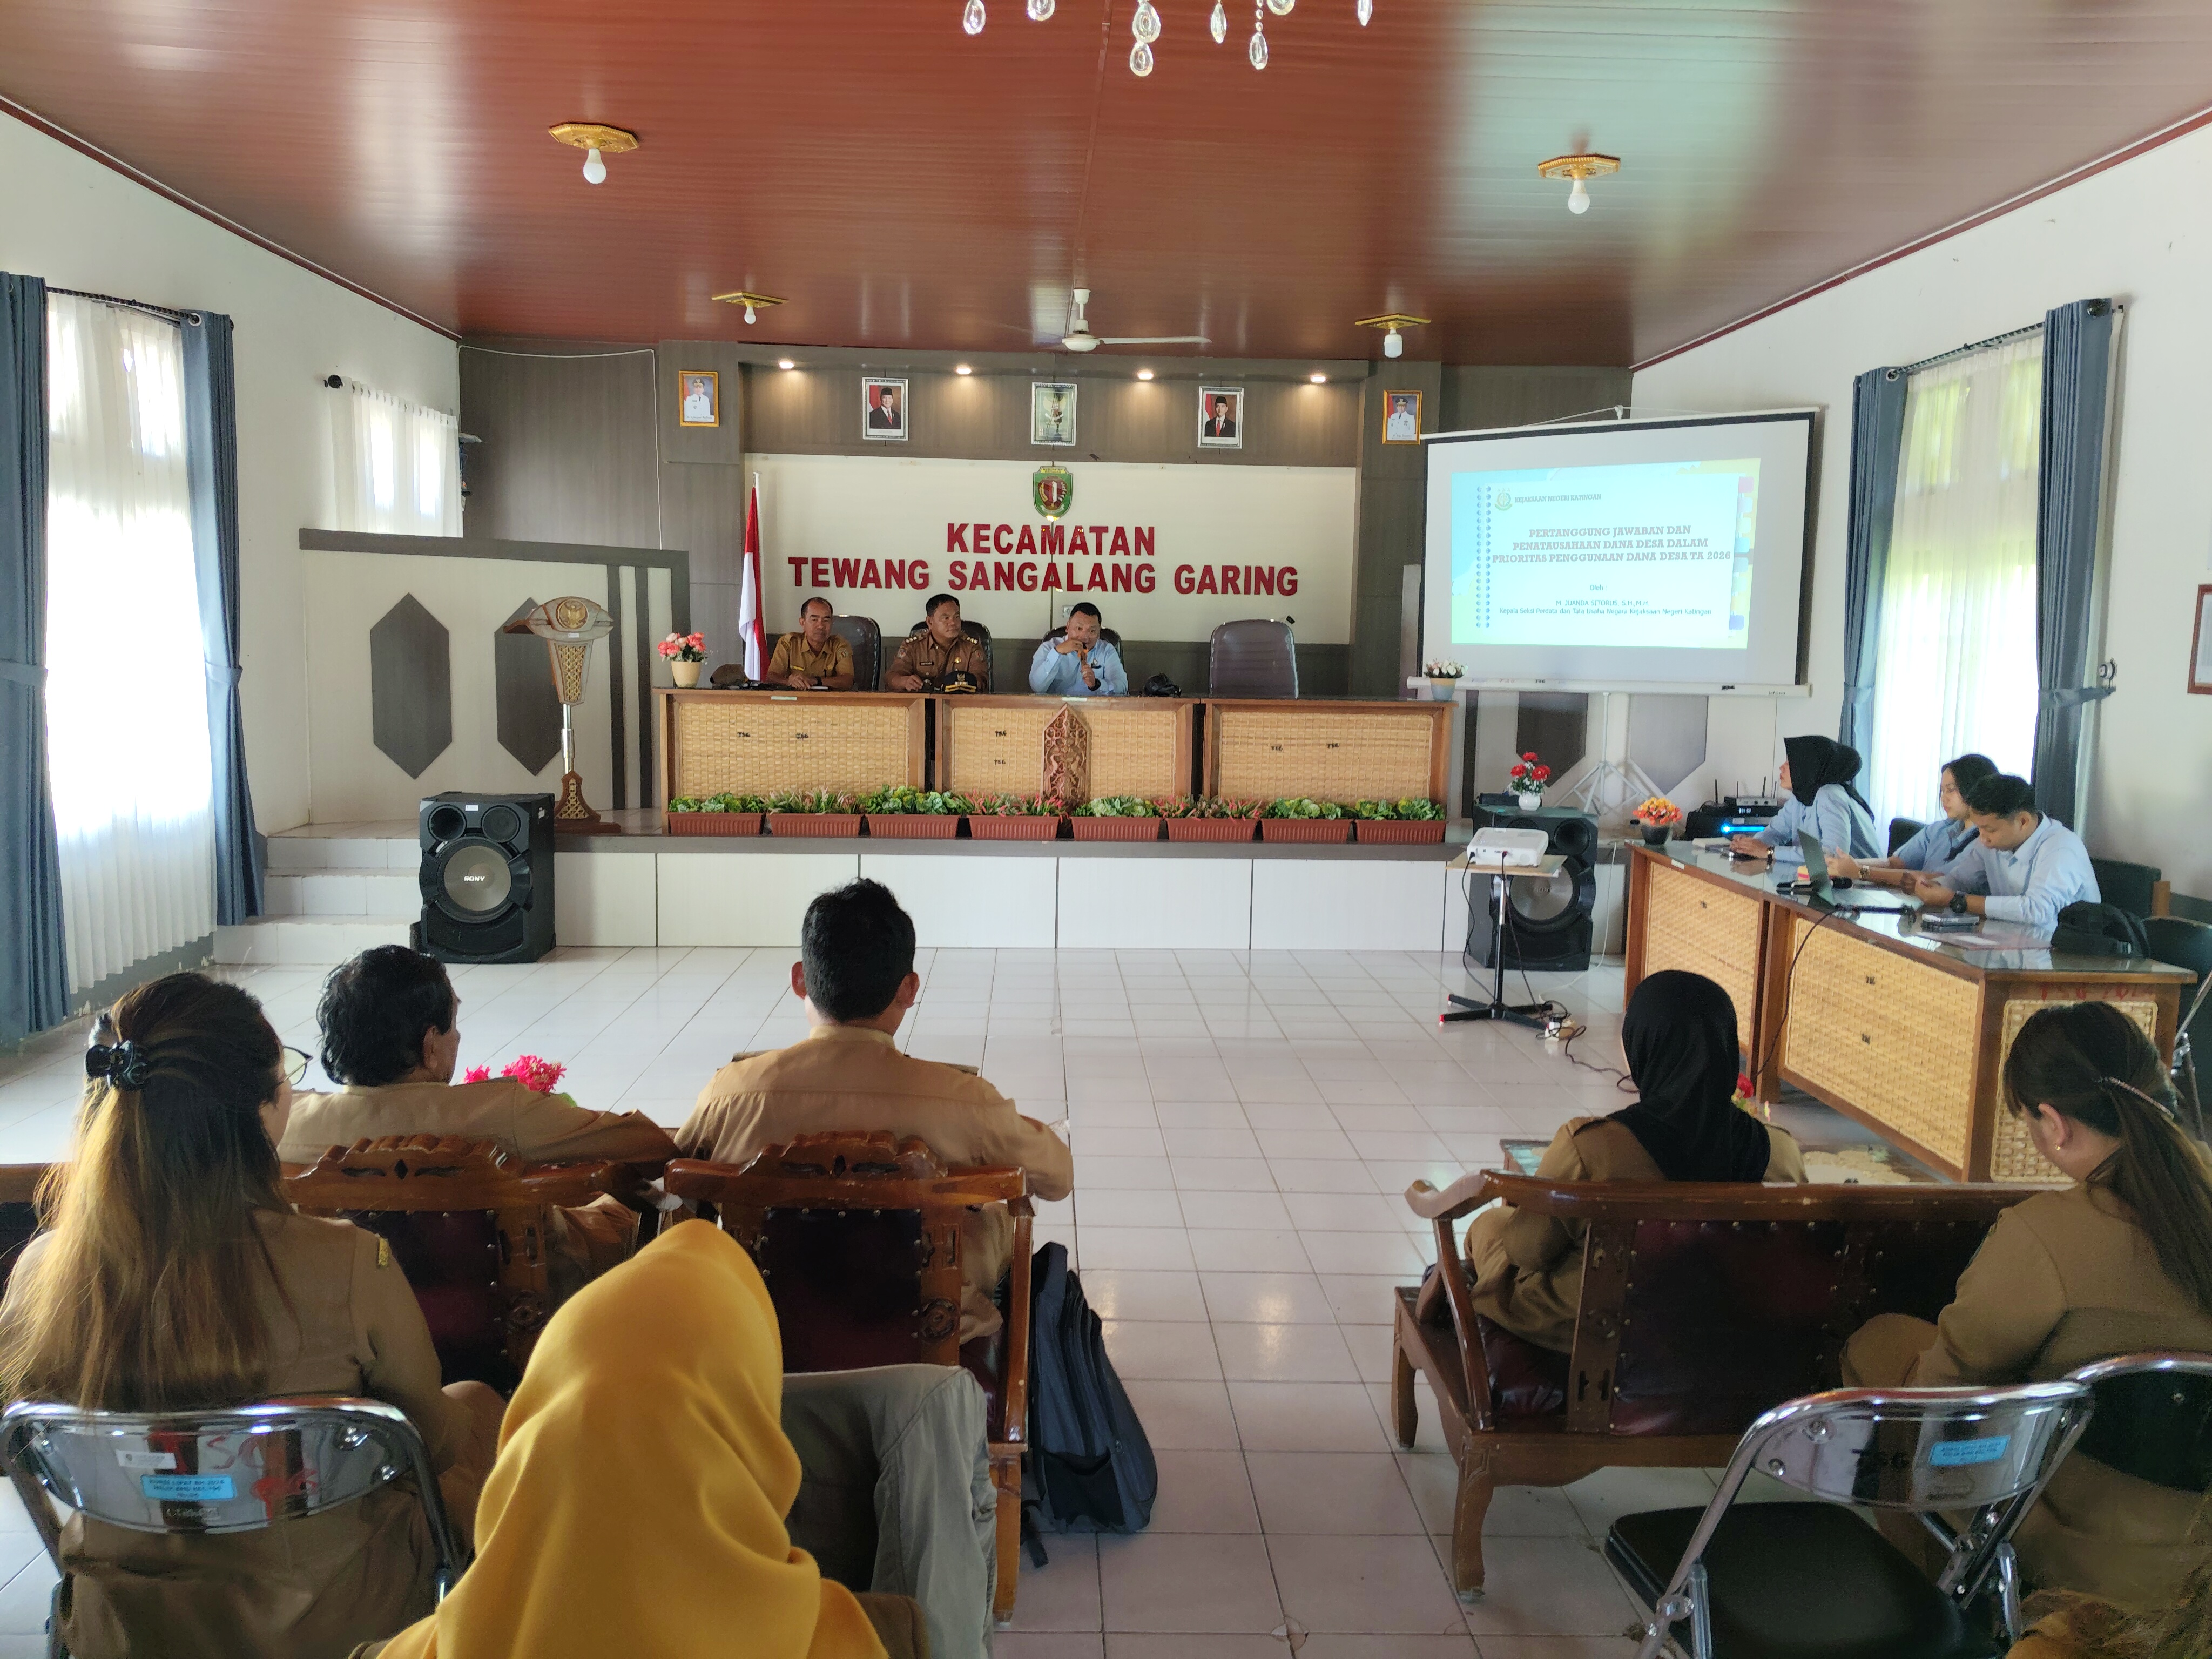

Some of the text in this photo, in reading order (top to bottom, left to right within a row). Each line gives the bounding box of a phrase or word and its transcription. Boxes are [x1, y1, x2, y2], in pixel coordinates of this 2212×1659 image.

[1515, 495, 1547, 503] KEJAKSAAN
[1529, 525, 1691, 538] PERTANGGUNG JAWABAN DAN
[947, 522, 1155, 556] KECAMATAN
[1513, 538, 1708, 550] PENATAUSAHAAN DANA DESA DALAM
[1492, 551, 1731, 563] PRIORITAS PENGGUNAAN DANA DESA TA 2026
[788, 556, 1298, 596] TEWANG SANGALANG GARING
